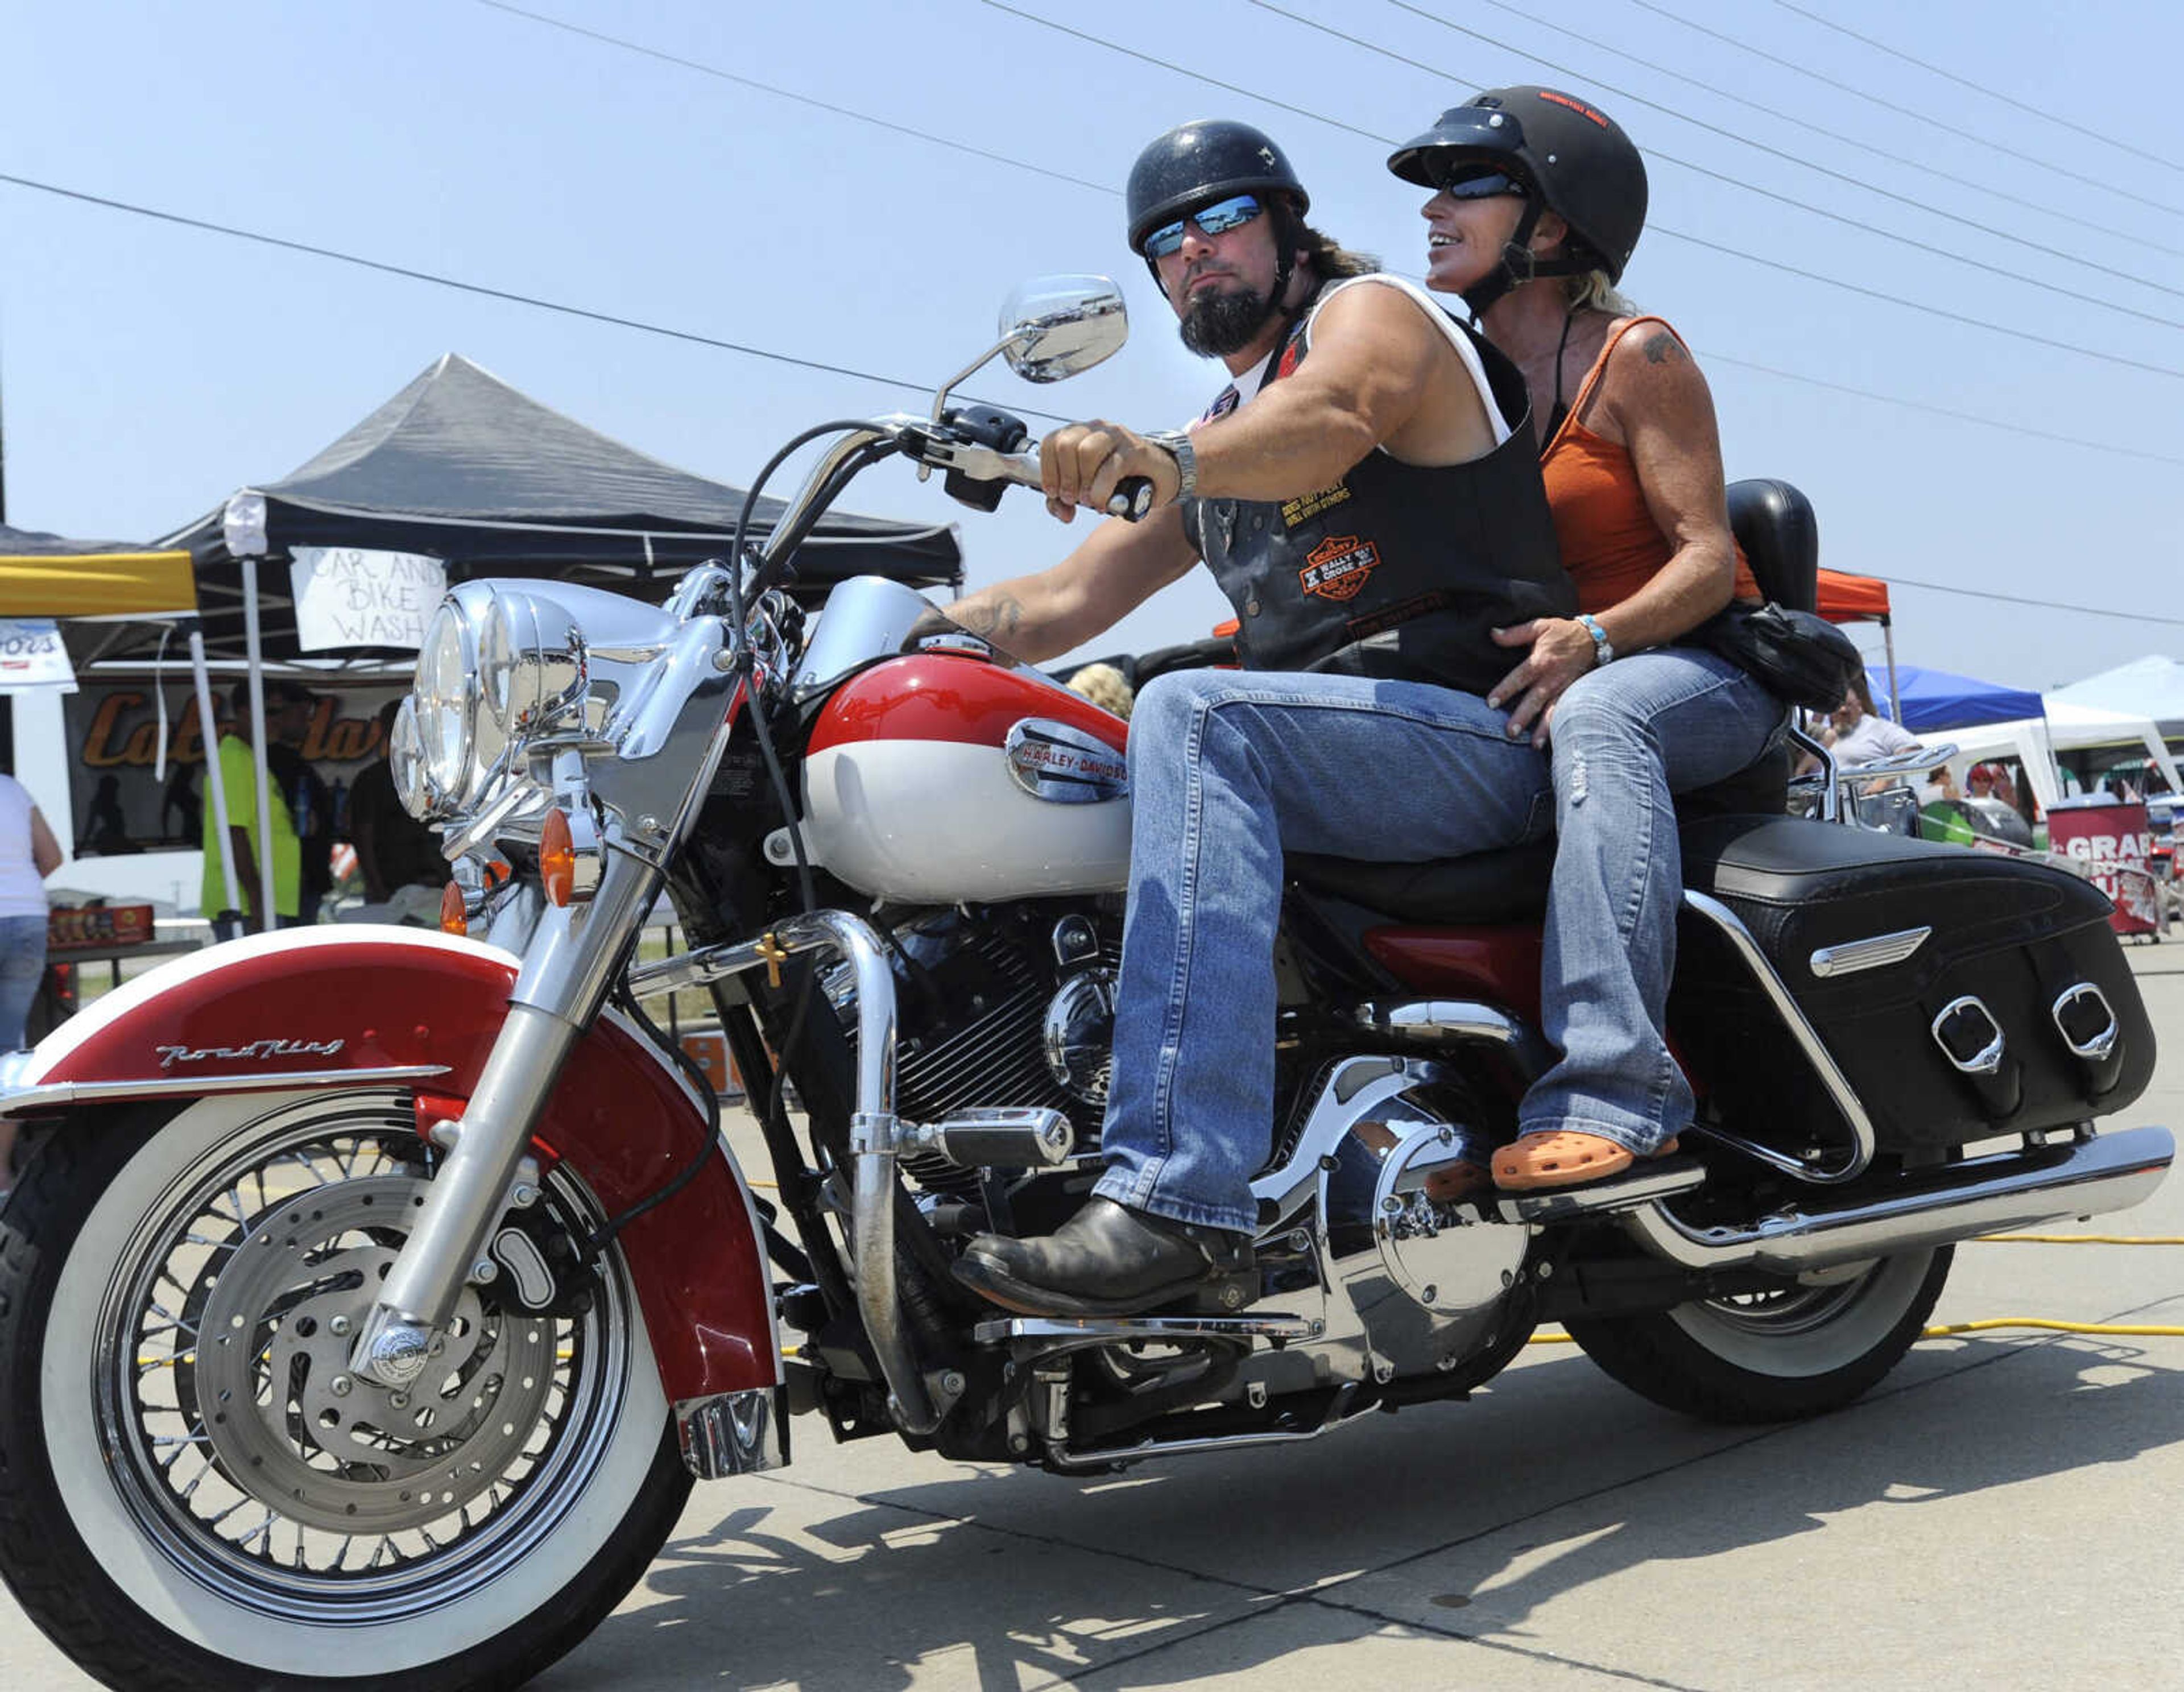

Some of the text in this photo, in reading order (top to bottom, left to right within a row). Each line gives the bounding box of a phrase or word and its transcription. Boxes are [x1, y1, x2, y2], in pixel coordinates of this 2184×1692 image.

[311, 549, 441, 587] CAR AND
[336, 578, 420, 611] BIKE
[330, 612, 424, 641] WASH
[1023, 746, 1127, 781] HARLEY-DAVIDSO
